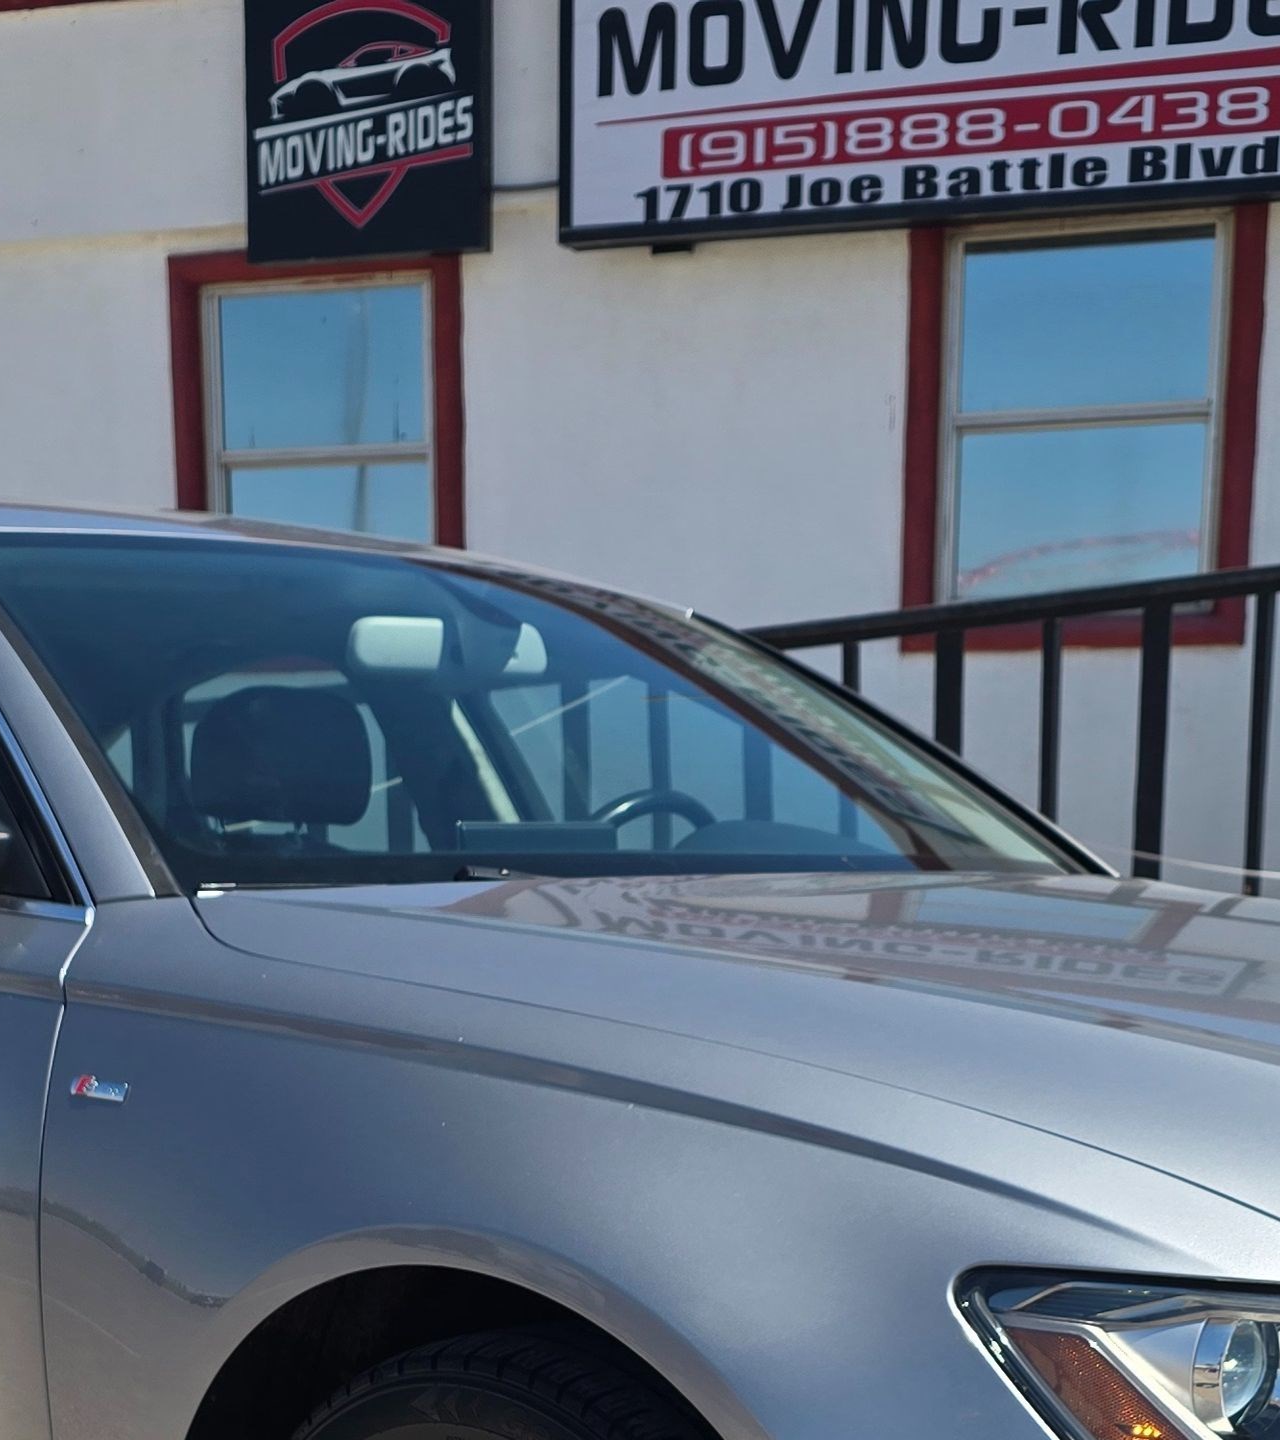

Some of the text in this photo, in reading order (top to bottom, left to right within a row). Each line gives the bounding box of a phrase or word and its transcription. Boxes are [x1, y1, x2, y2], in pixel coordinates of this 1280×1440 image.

[256, 95, 474, 187] MOVING-RIDES
[677, 85, 1271, 174] (915)888-0438
[634, 177, 763, 225] 1710
[779, 173, 885, 211] Joe
[902, 153, 1109, 200] Battle
